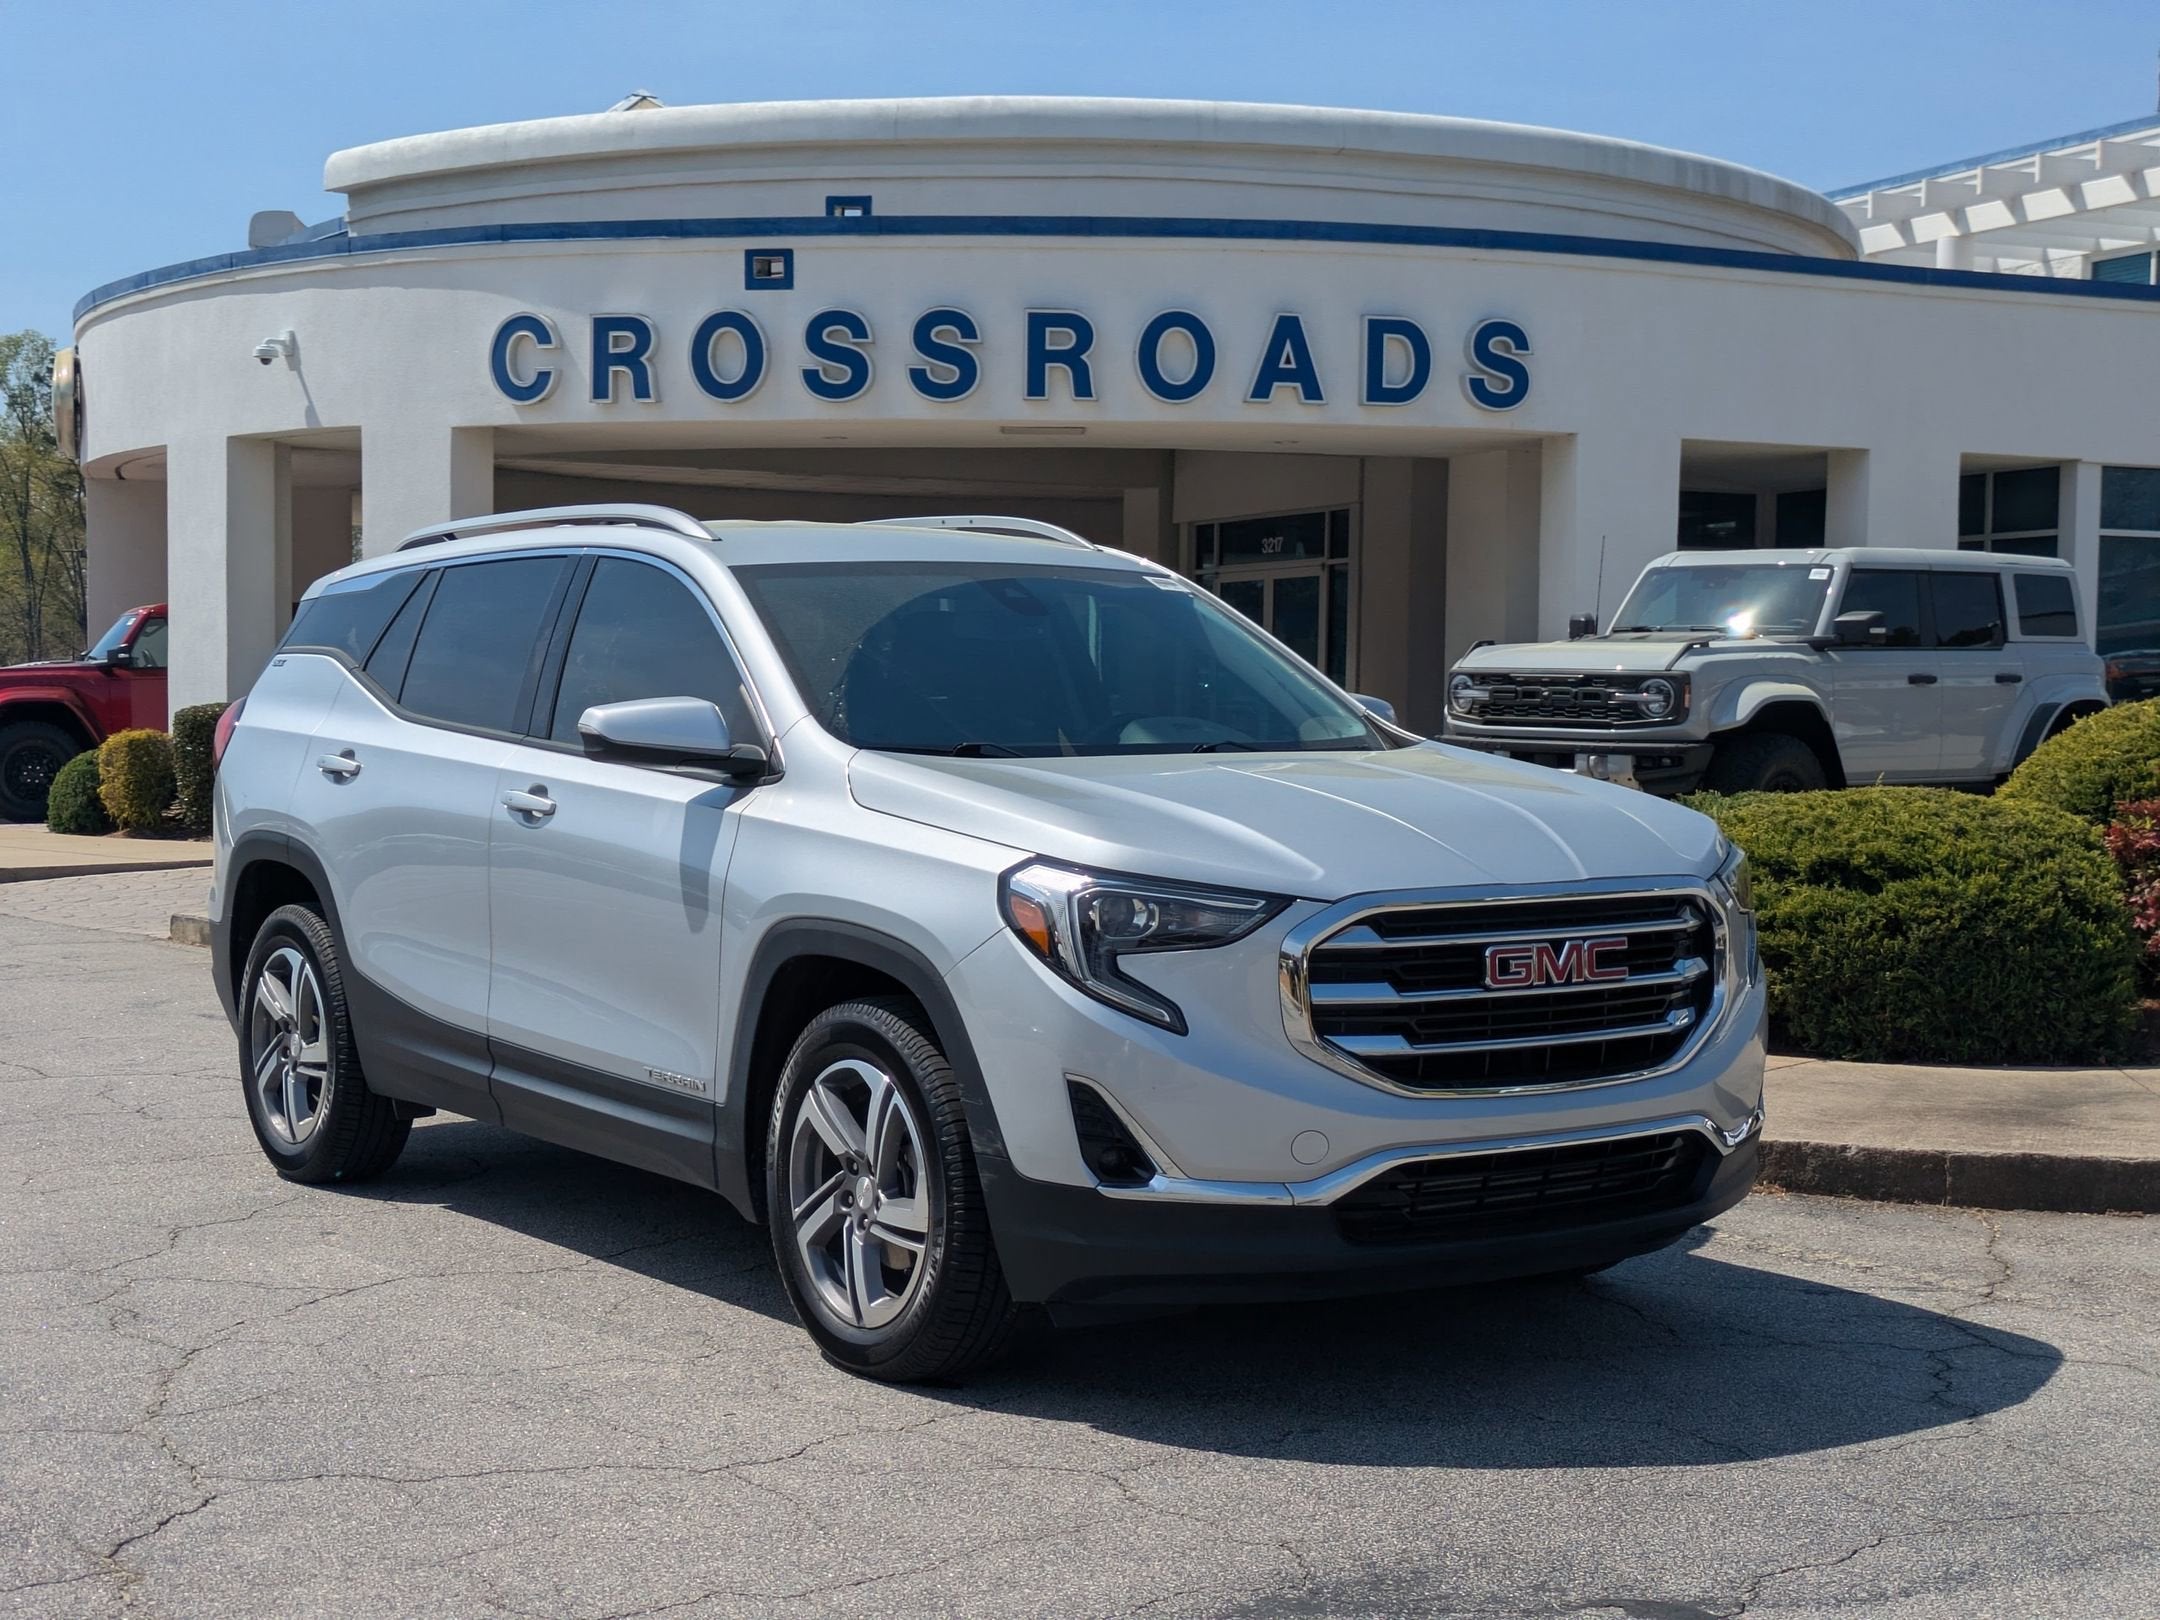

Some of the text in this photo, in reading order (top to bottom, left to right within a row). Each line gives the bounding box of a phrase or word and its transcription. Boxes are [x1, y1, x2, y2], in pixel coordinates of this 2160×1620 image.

[489, 306, 1534, 411] CROSSROADS
[1261, 536, 1284, 554] 3217
[1488, 685, 1609, 707] FORD
[1485, 937, 1629, 988] GMC
[642, 1065, 706, 1093] TERRAIN
